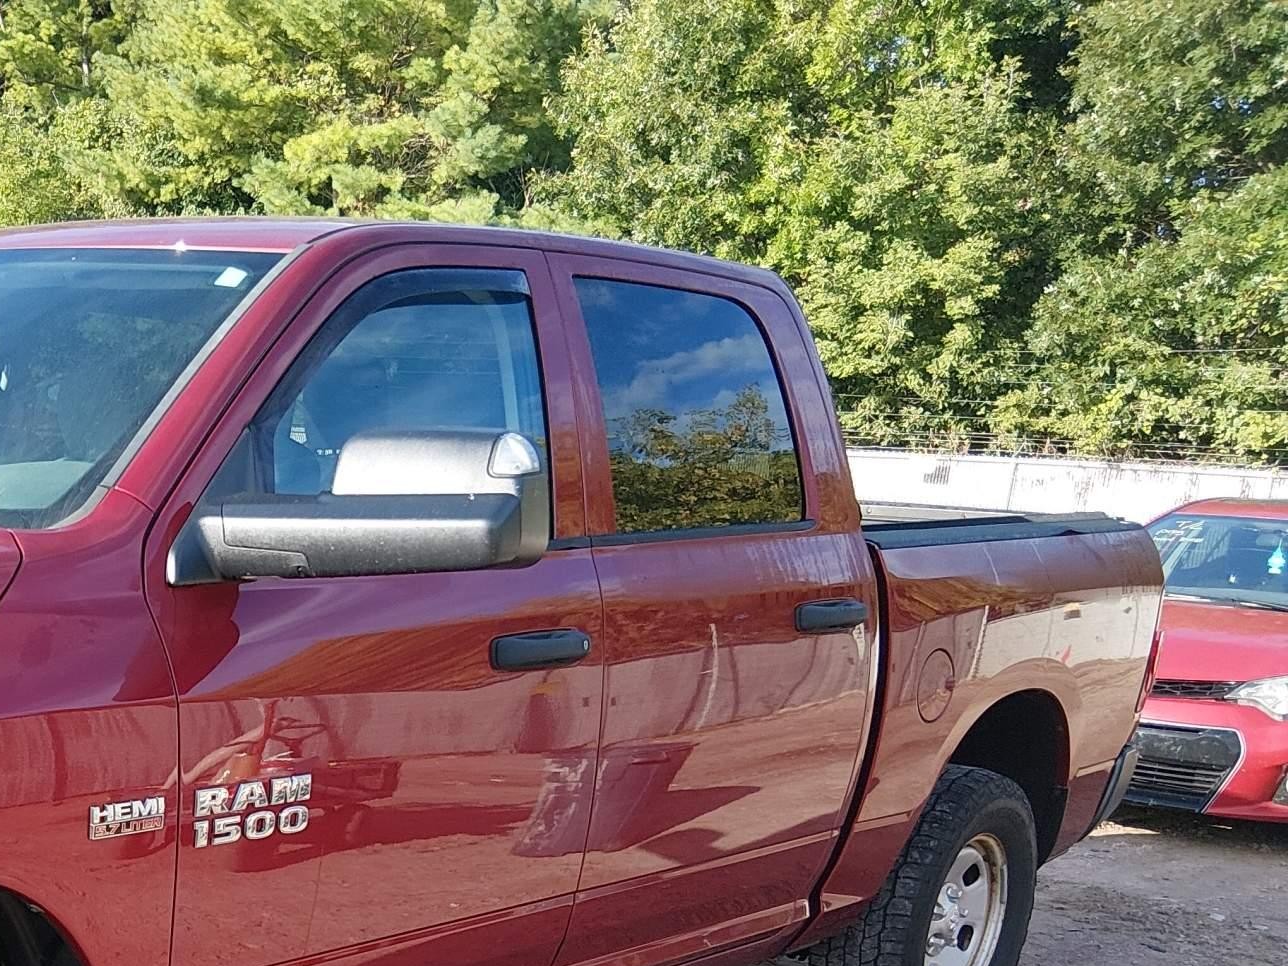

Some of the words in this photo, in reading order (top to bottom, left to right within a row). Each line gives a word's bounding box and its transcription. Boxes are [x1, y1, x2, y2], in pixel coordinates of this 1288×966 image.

[89, 796, 166, 824] HEMI
[194, 773, 312, 818] RAM
[94, 821, 120, 837] 5.7
[120, 816, 162, 833] LITER
[193, 804, 310, 849] 1500
